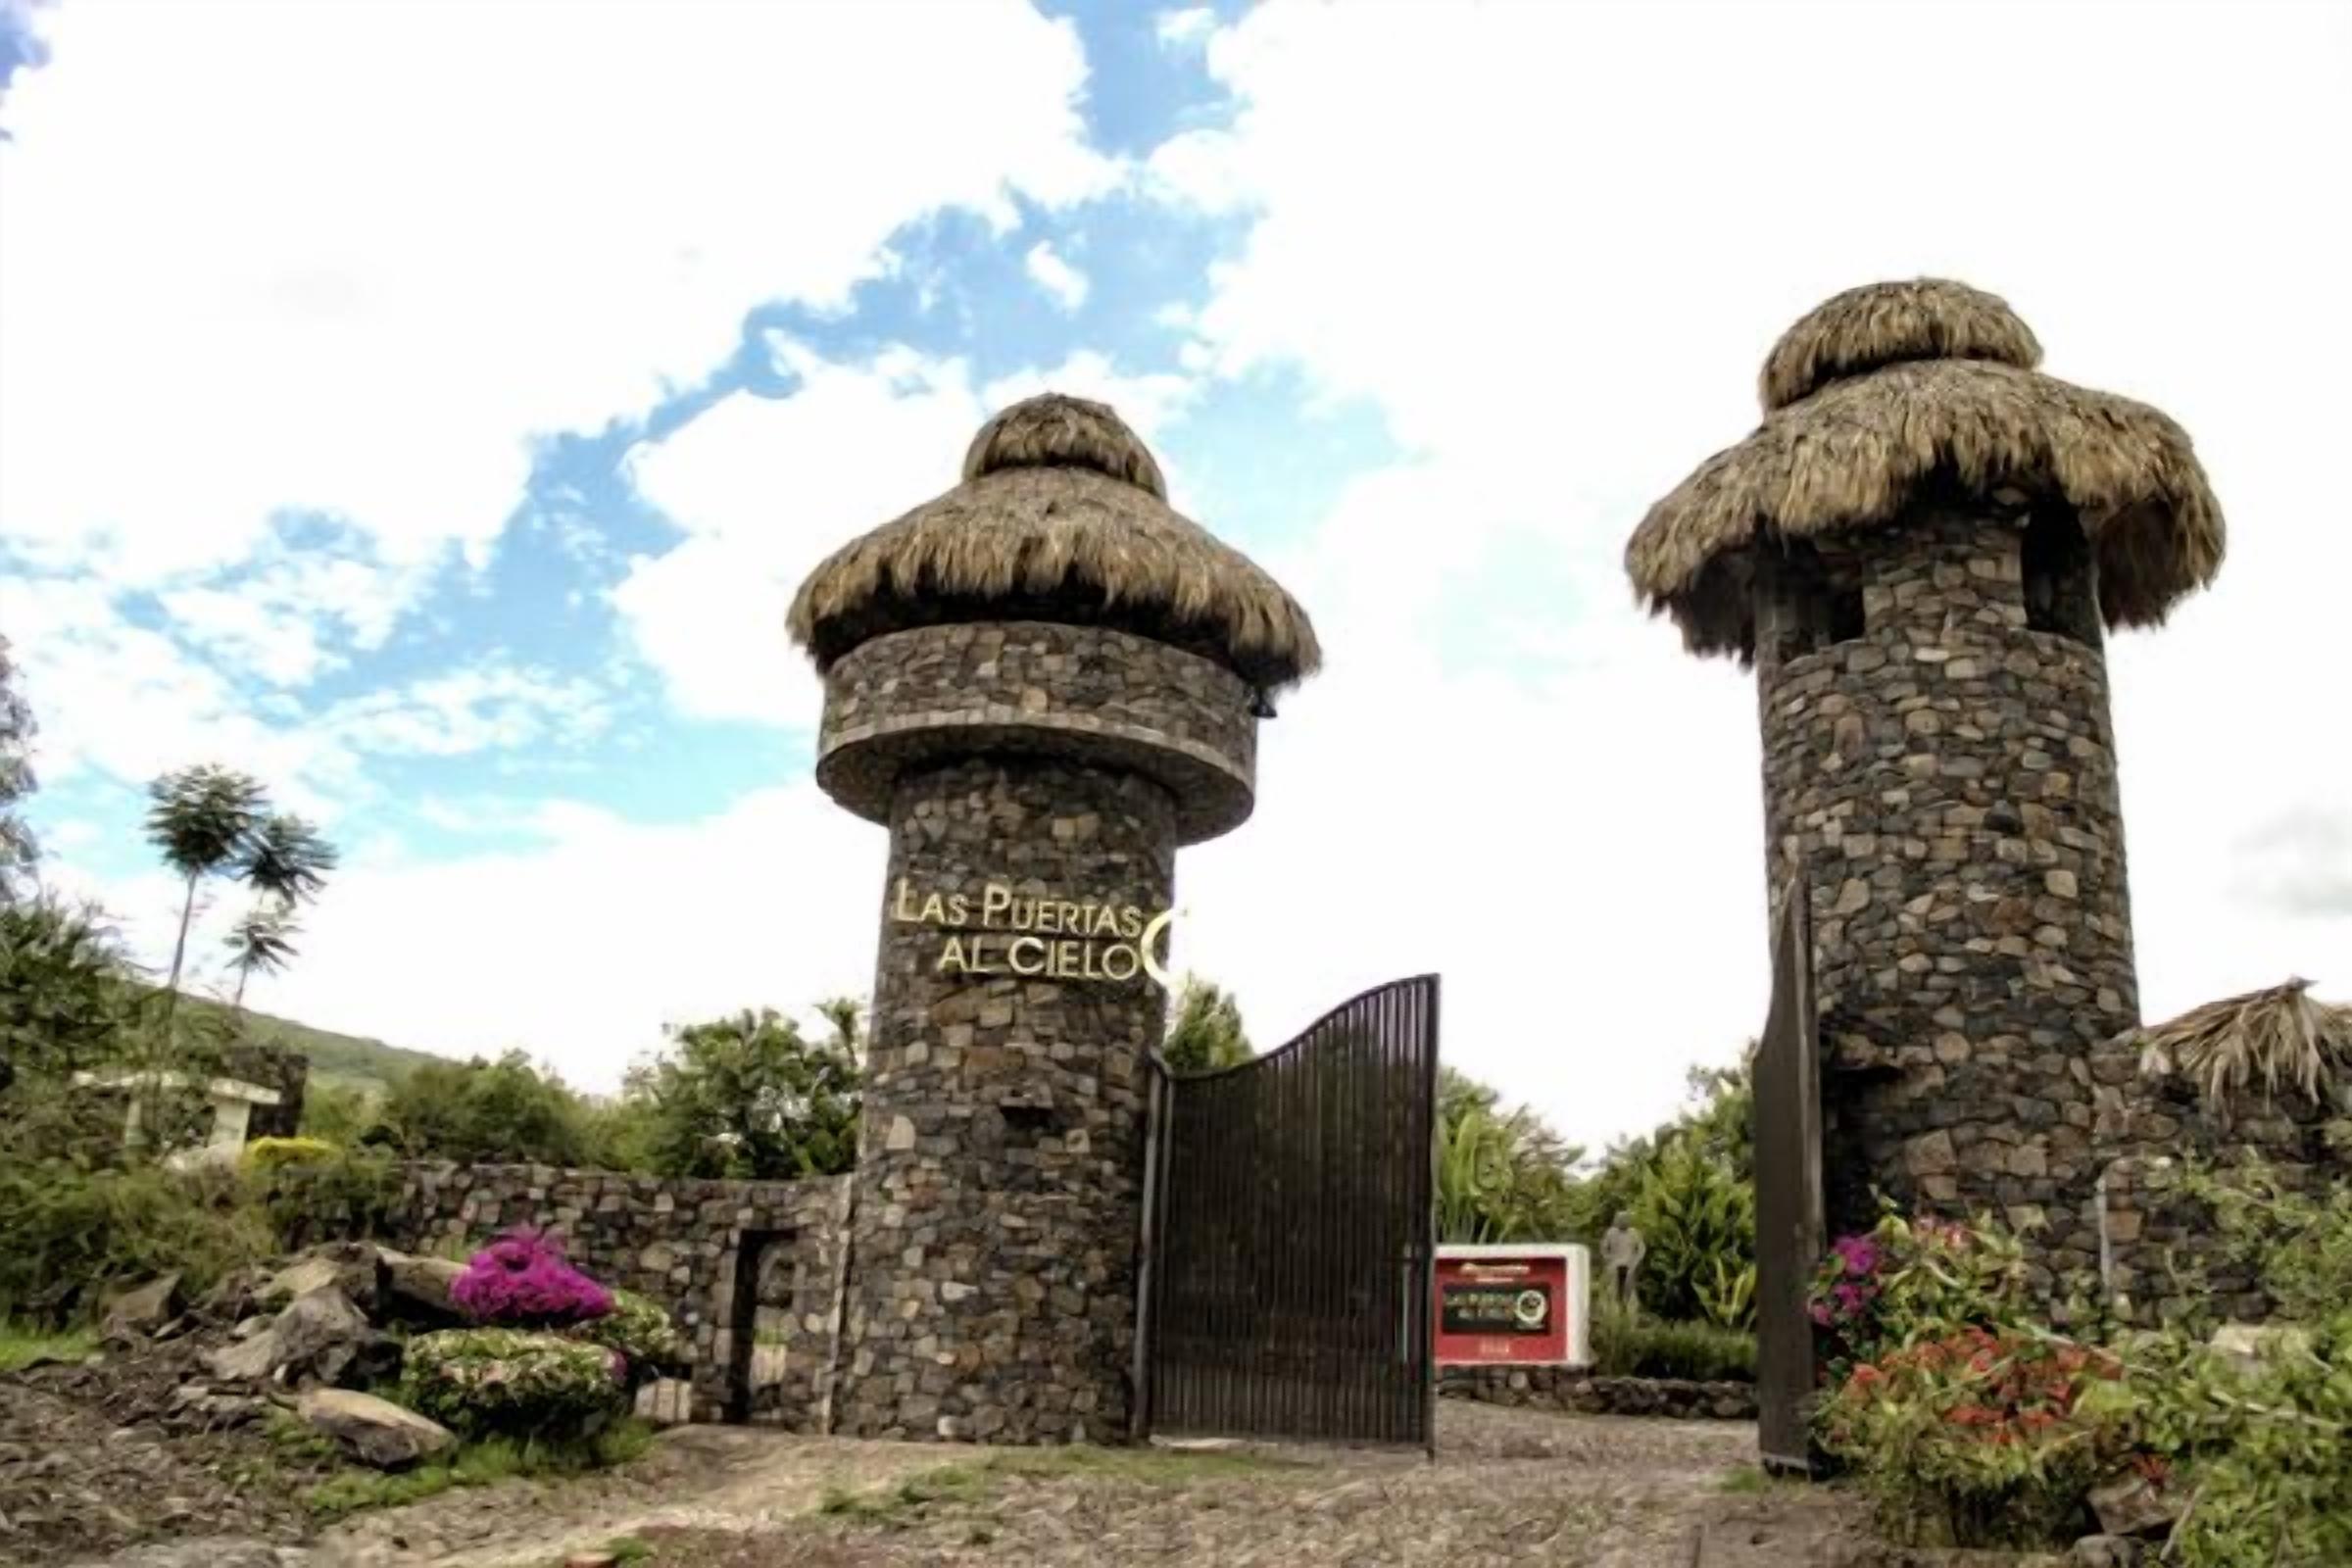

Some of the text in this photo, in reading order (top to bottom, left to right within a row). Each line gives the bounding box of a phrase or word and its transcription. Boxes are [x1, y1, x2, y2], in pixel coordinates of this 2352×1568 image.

[894, 877, 1143, 938] LAS PUERTAS
[937, 936, 1139, 980] AL CIELO
